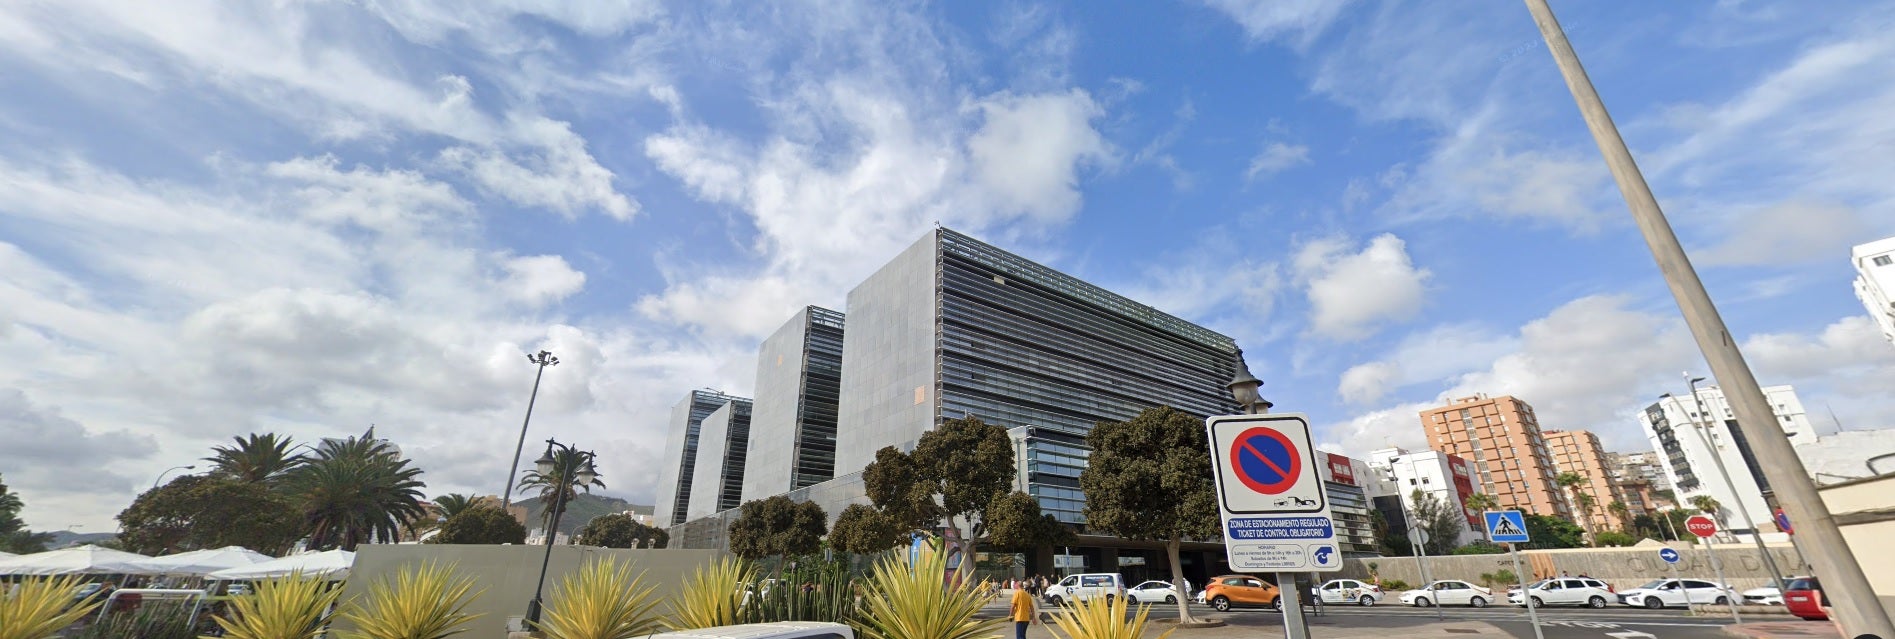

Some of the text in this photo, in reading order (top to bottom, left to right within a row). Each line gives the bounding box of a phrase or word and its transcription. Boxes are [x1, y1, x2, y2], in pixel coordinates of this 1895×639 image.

[1230, 519, 1329, 529] ZONA DE ESTACIONAMIENTO REGULADO
[1237, 528, 1324, 538] TICKET DE CONTROL OBLIGATORIO
[1626, 556, 1725, 572] CIUDAD
